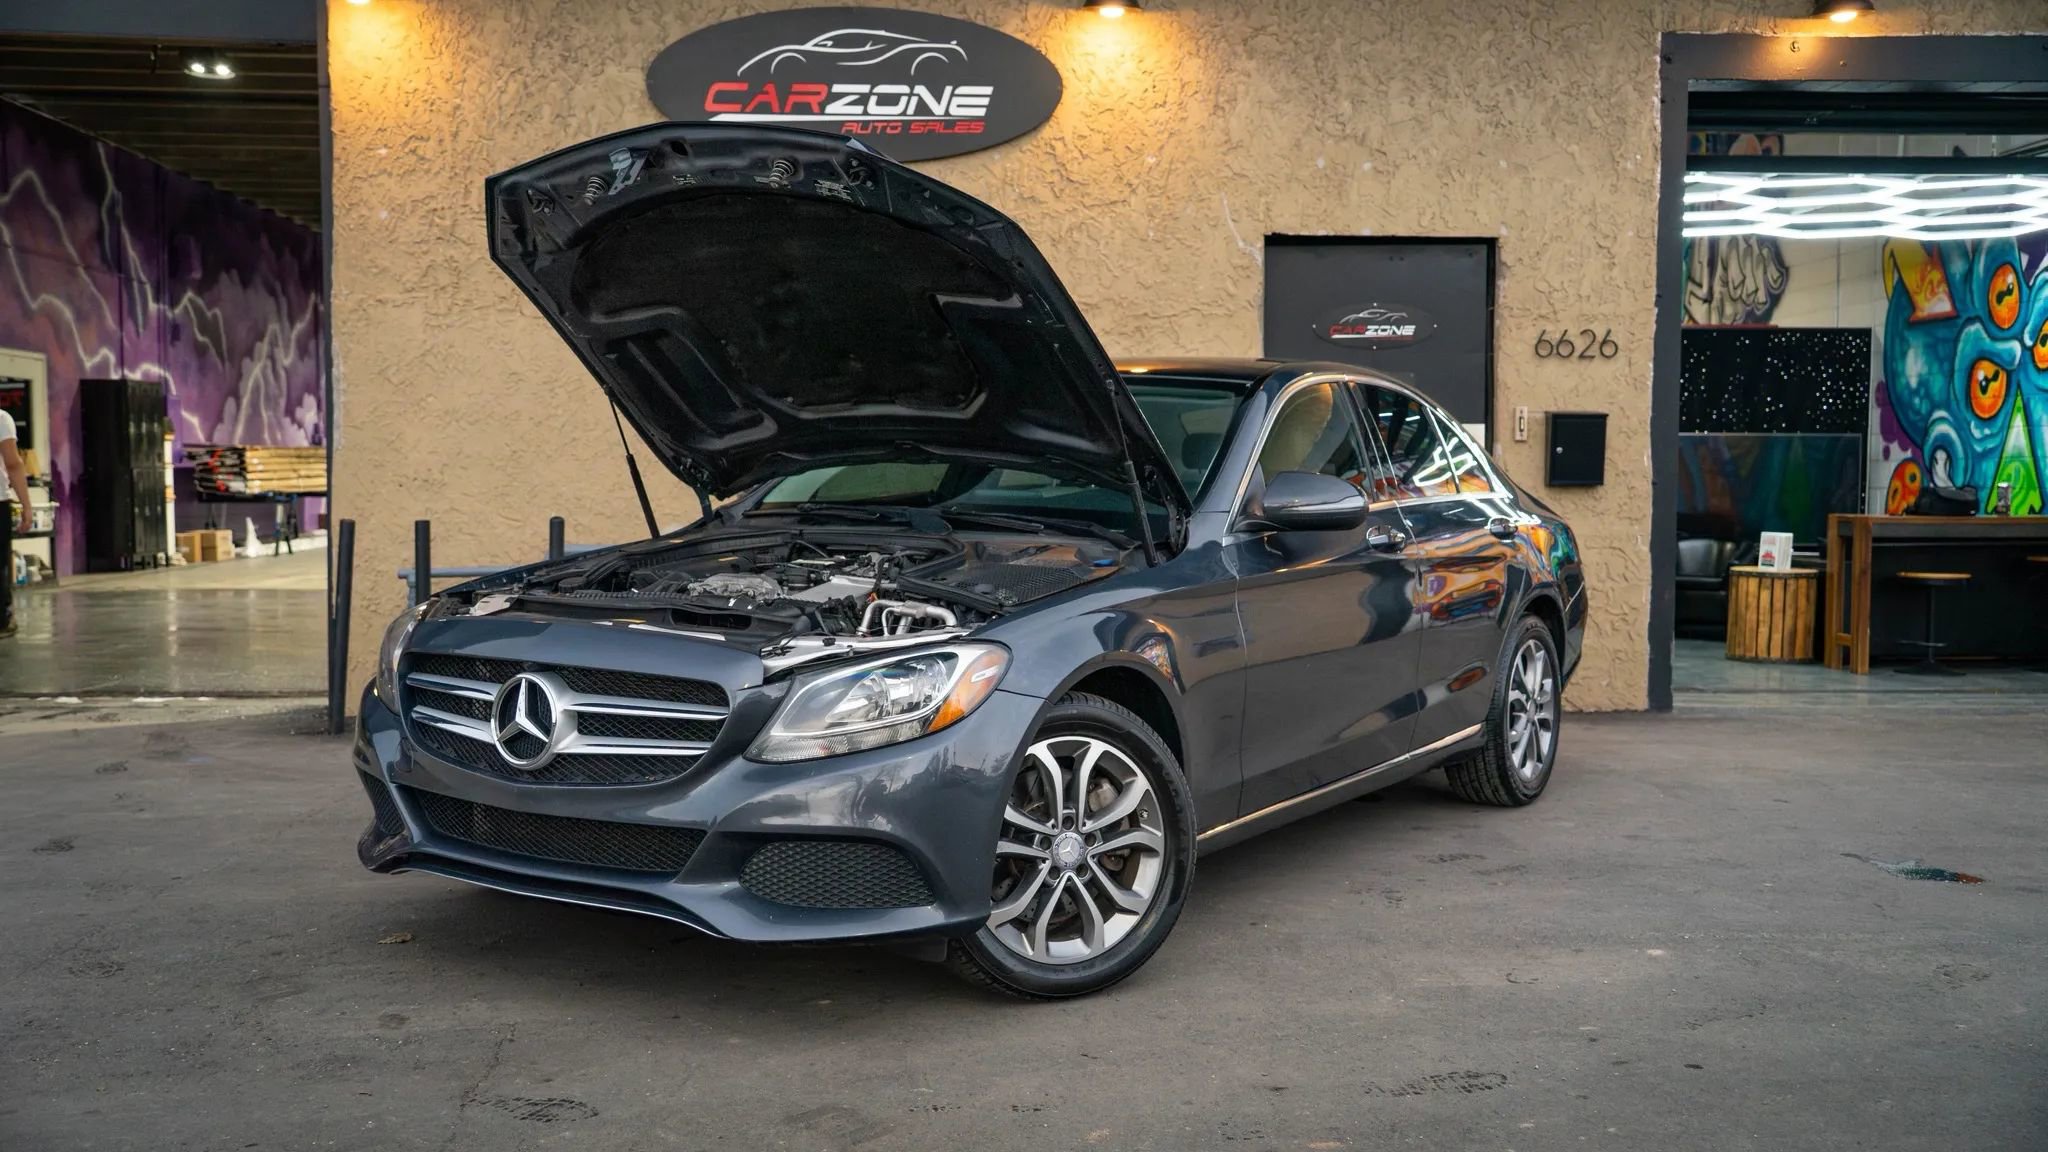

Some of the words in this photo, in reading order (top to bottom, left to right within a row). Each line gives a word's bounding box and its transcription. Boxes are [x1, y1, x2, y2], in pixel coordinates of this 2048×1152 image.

[704, 81, 994, 116] CARZONE
[841, 121, 902, 135] AUTO
[908, 121, 985, 134] SALES
[1329, 323, 1416, 336] CARZONE
[1534, 328, 1619, 359] 6626
